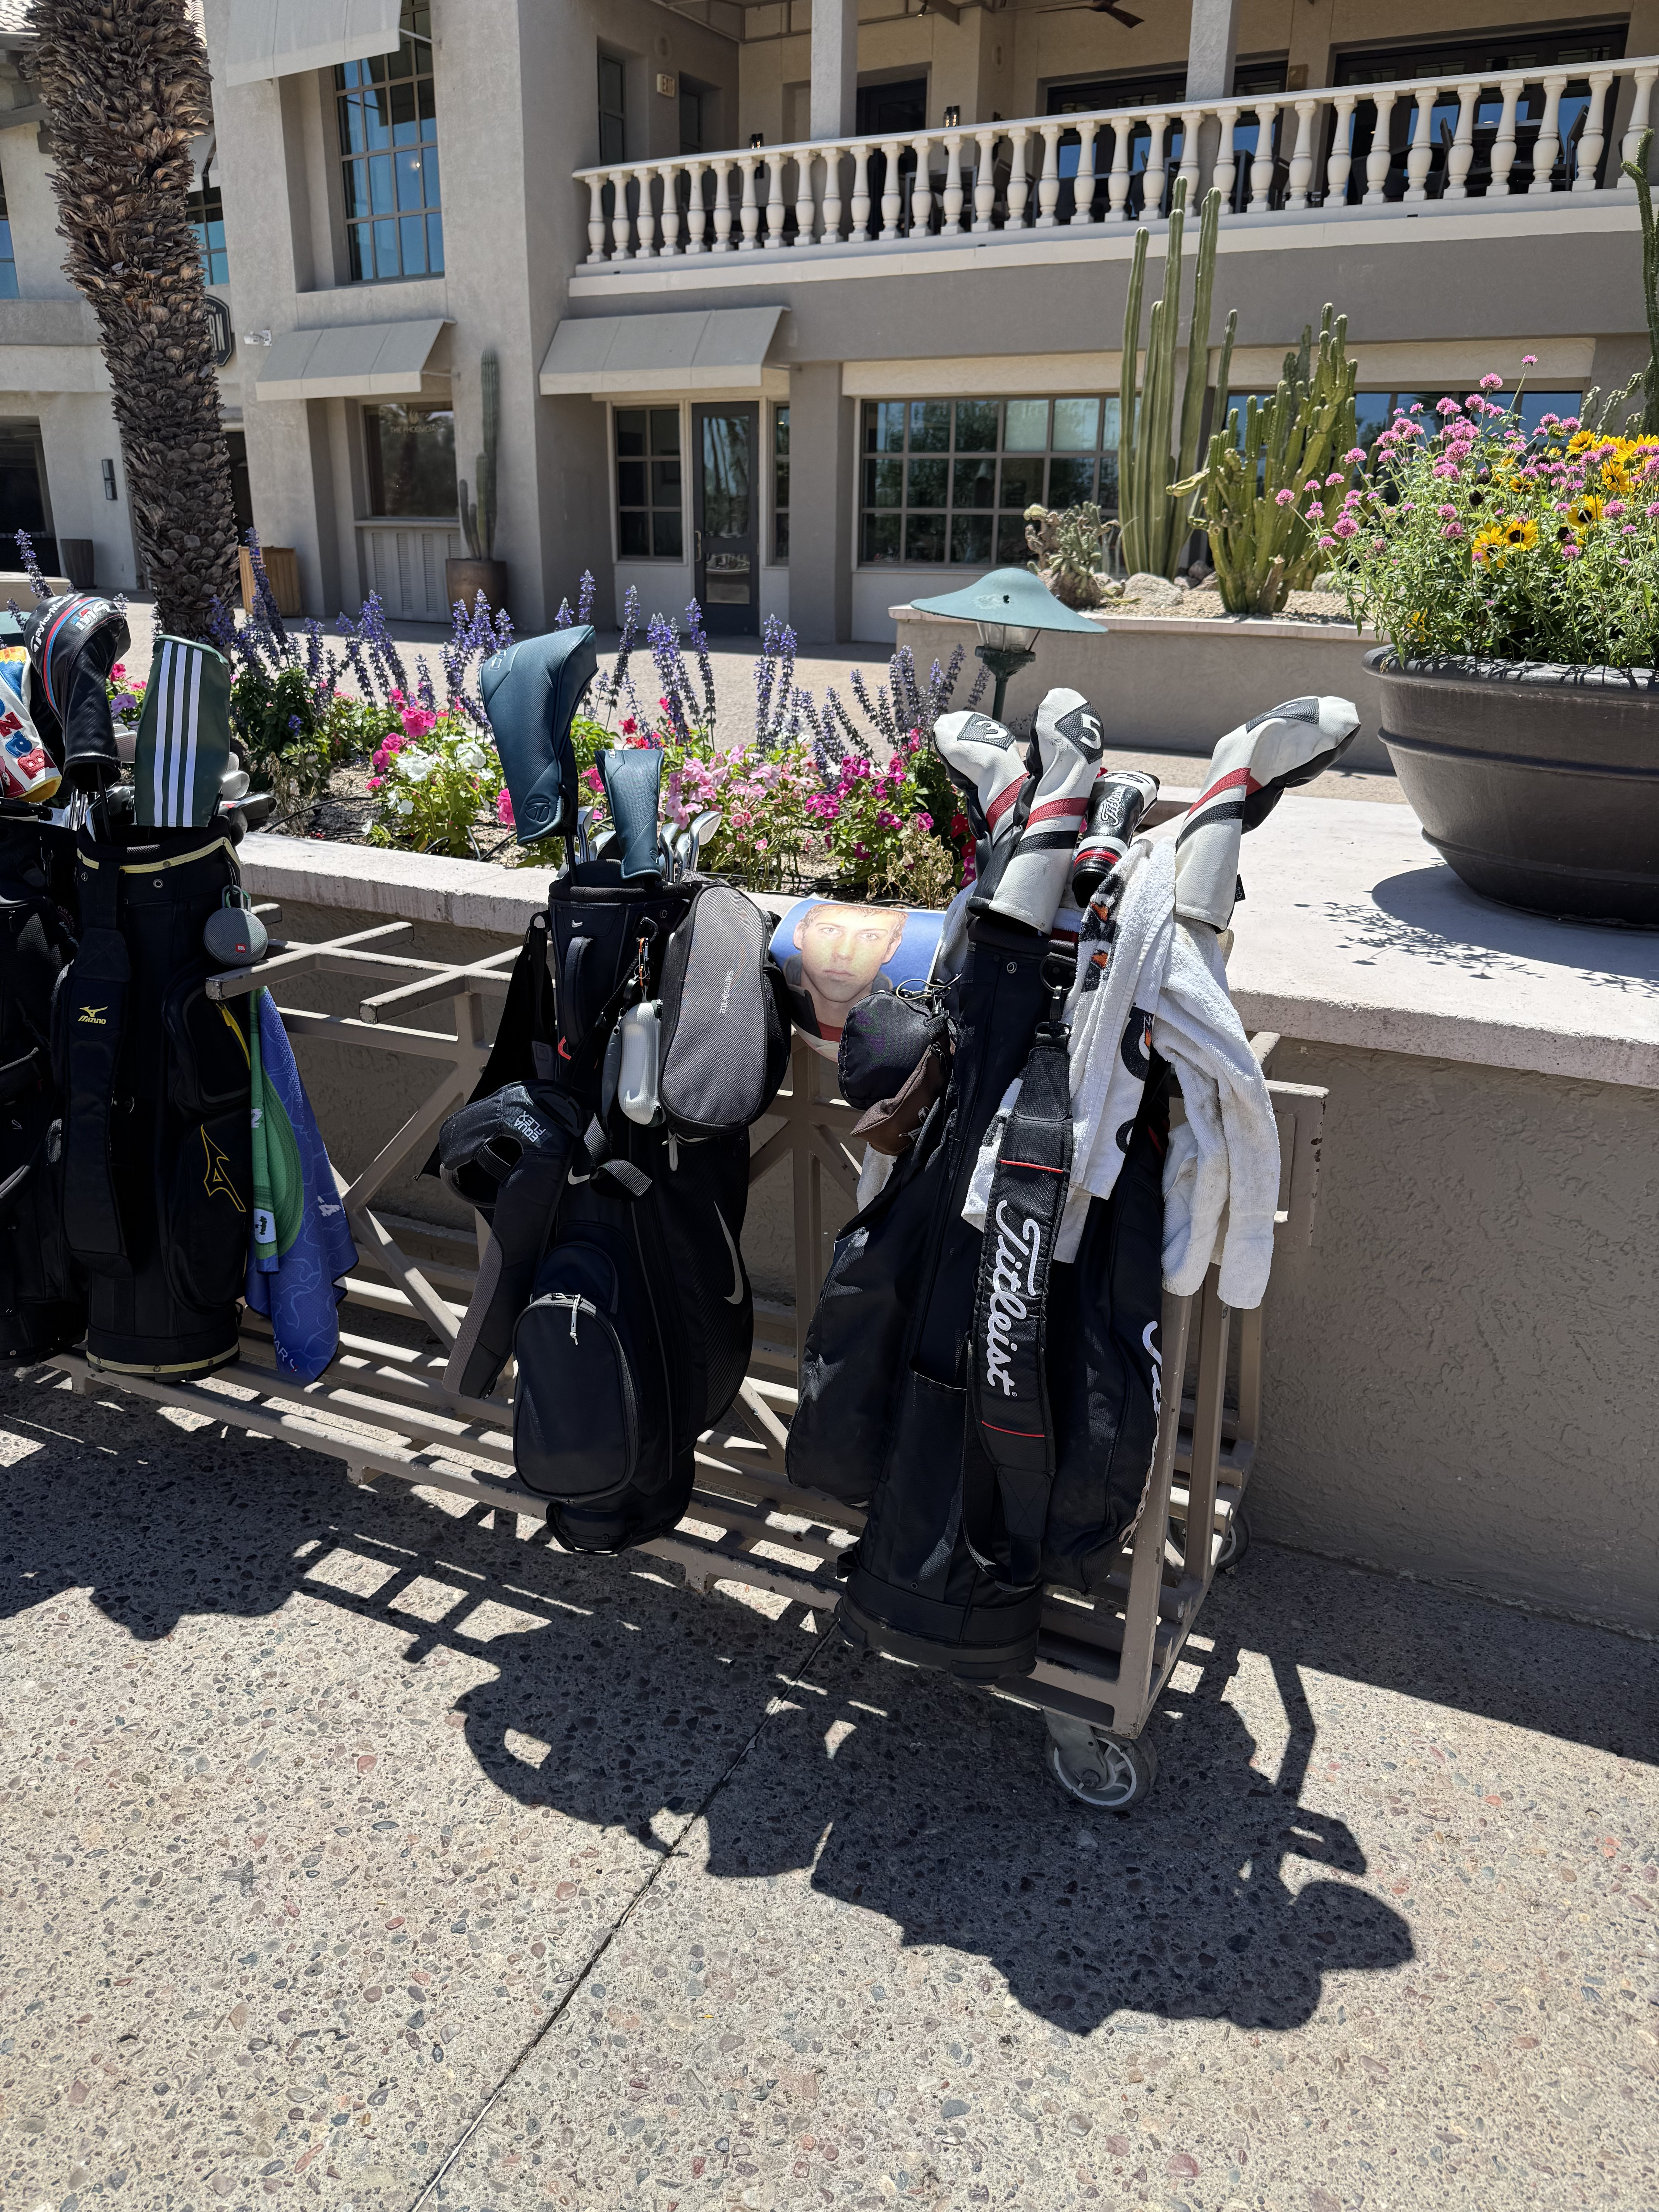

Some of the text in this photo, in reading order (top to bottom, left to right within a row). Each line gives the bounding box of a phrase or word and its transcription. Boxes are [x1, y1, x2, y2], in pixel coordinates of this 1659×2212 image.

[30, 593, 75, 653] TaylorMade
[975, 720, 1008, 739] 3
[1080, 713, 1101, 749] 5
[514, 1117, 539, 1143] EQUA
[519, 1110, 546, 1135] FLEX
[986, 1200, 1041, 1396] Titleist
